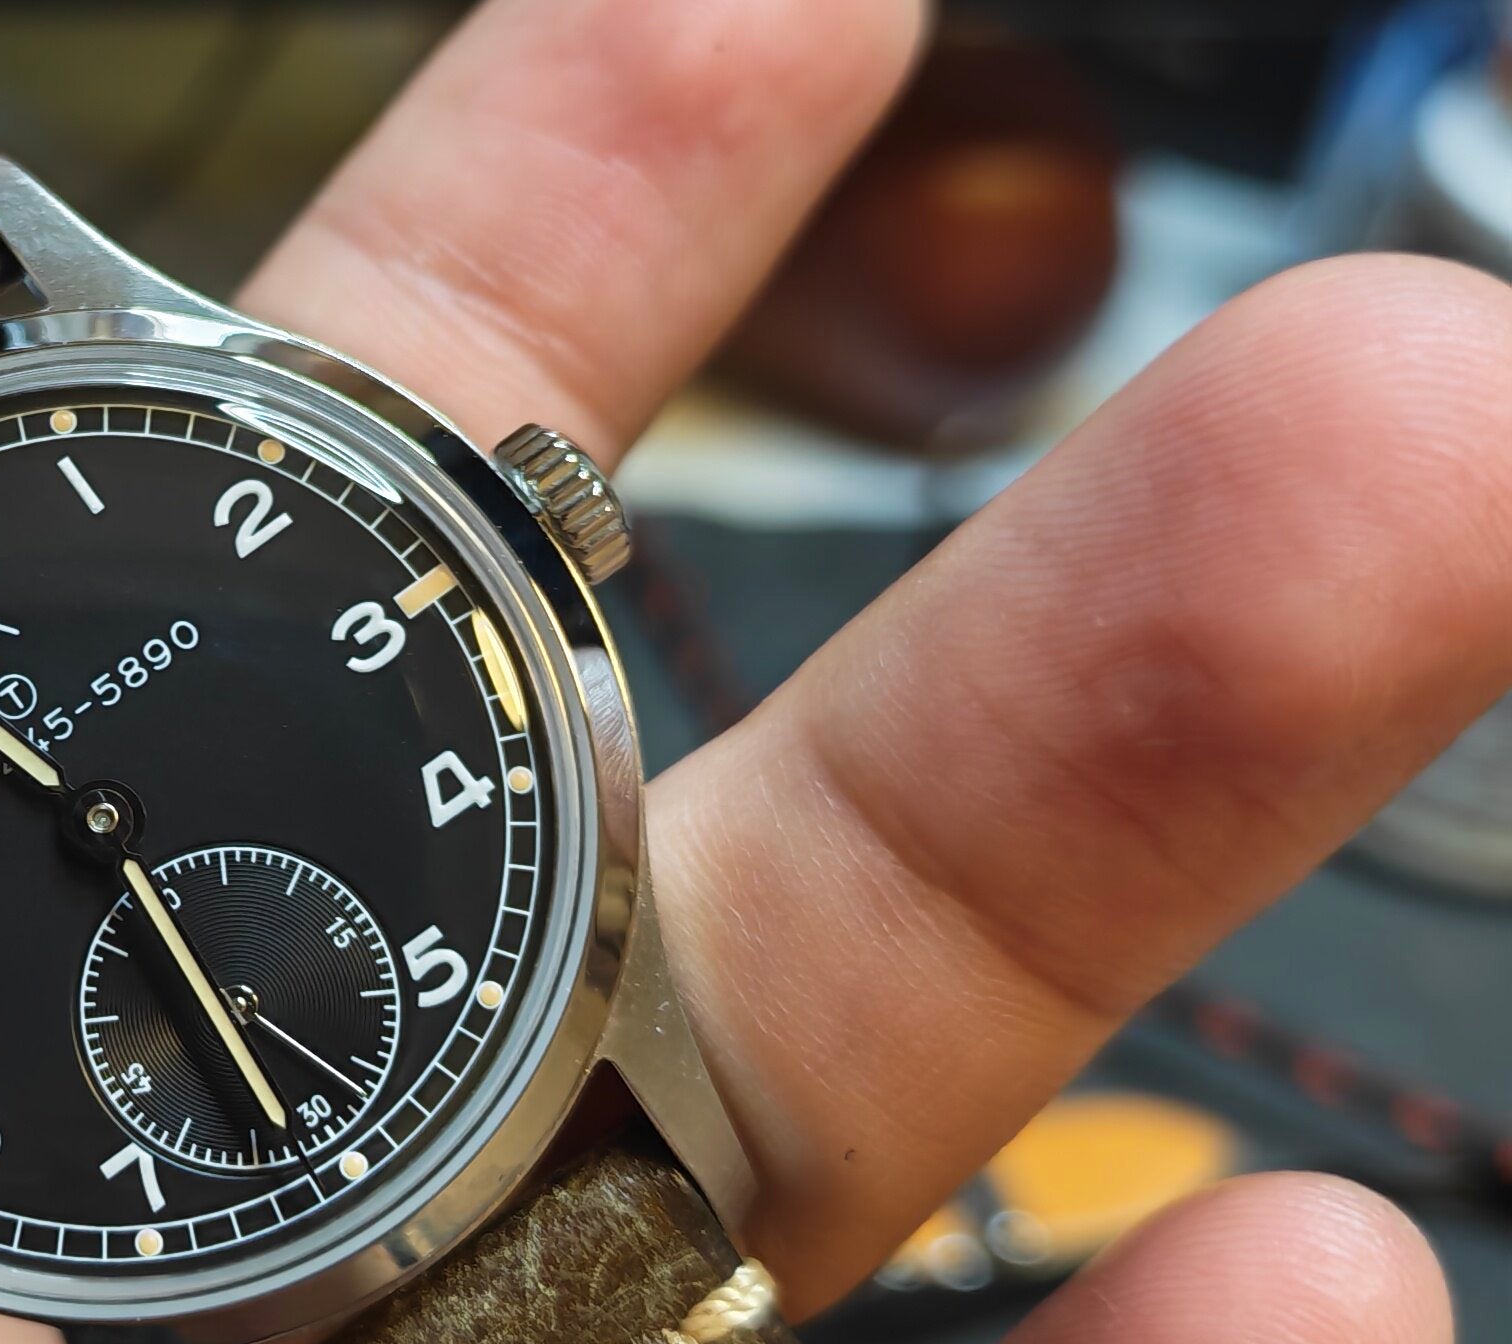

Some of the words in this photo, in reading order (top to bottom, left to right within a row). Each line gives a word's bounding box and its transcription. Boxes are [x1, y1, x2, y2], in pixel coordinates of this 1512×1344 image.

[56, 456, 105, 515] 1
[213, 479, 294, 559] 2
[331, 601, 406, 673] 3
[421, 750, 496, 828] 4
[325, 916, 358, 949] 15
[401, 924, 469, 1008] 5
[120, 1062, 153, 1095] 45
[296, 1094, 332, 1128] 30
[99, 1142, 166, 1213] 7
